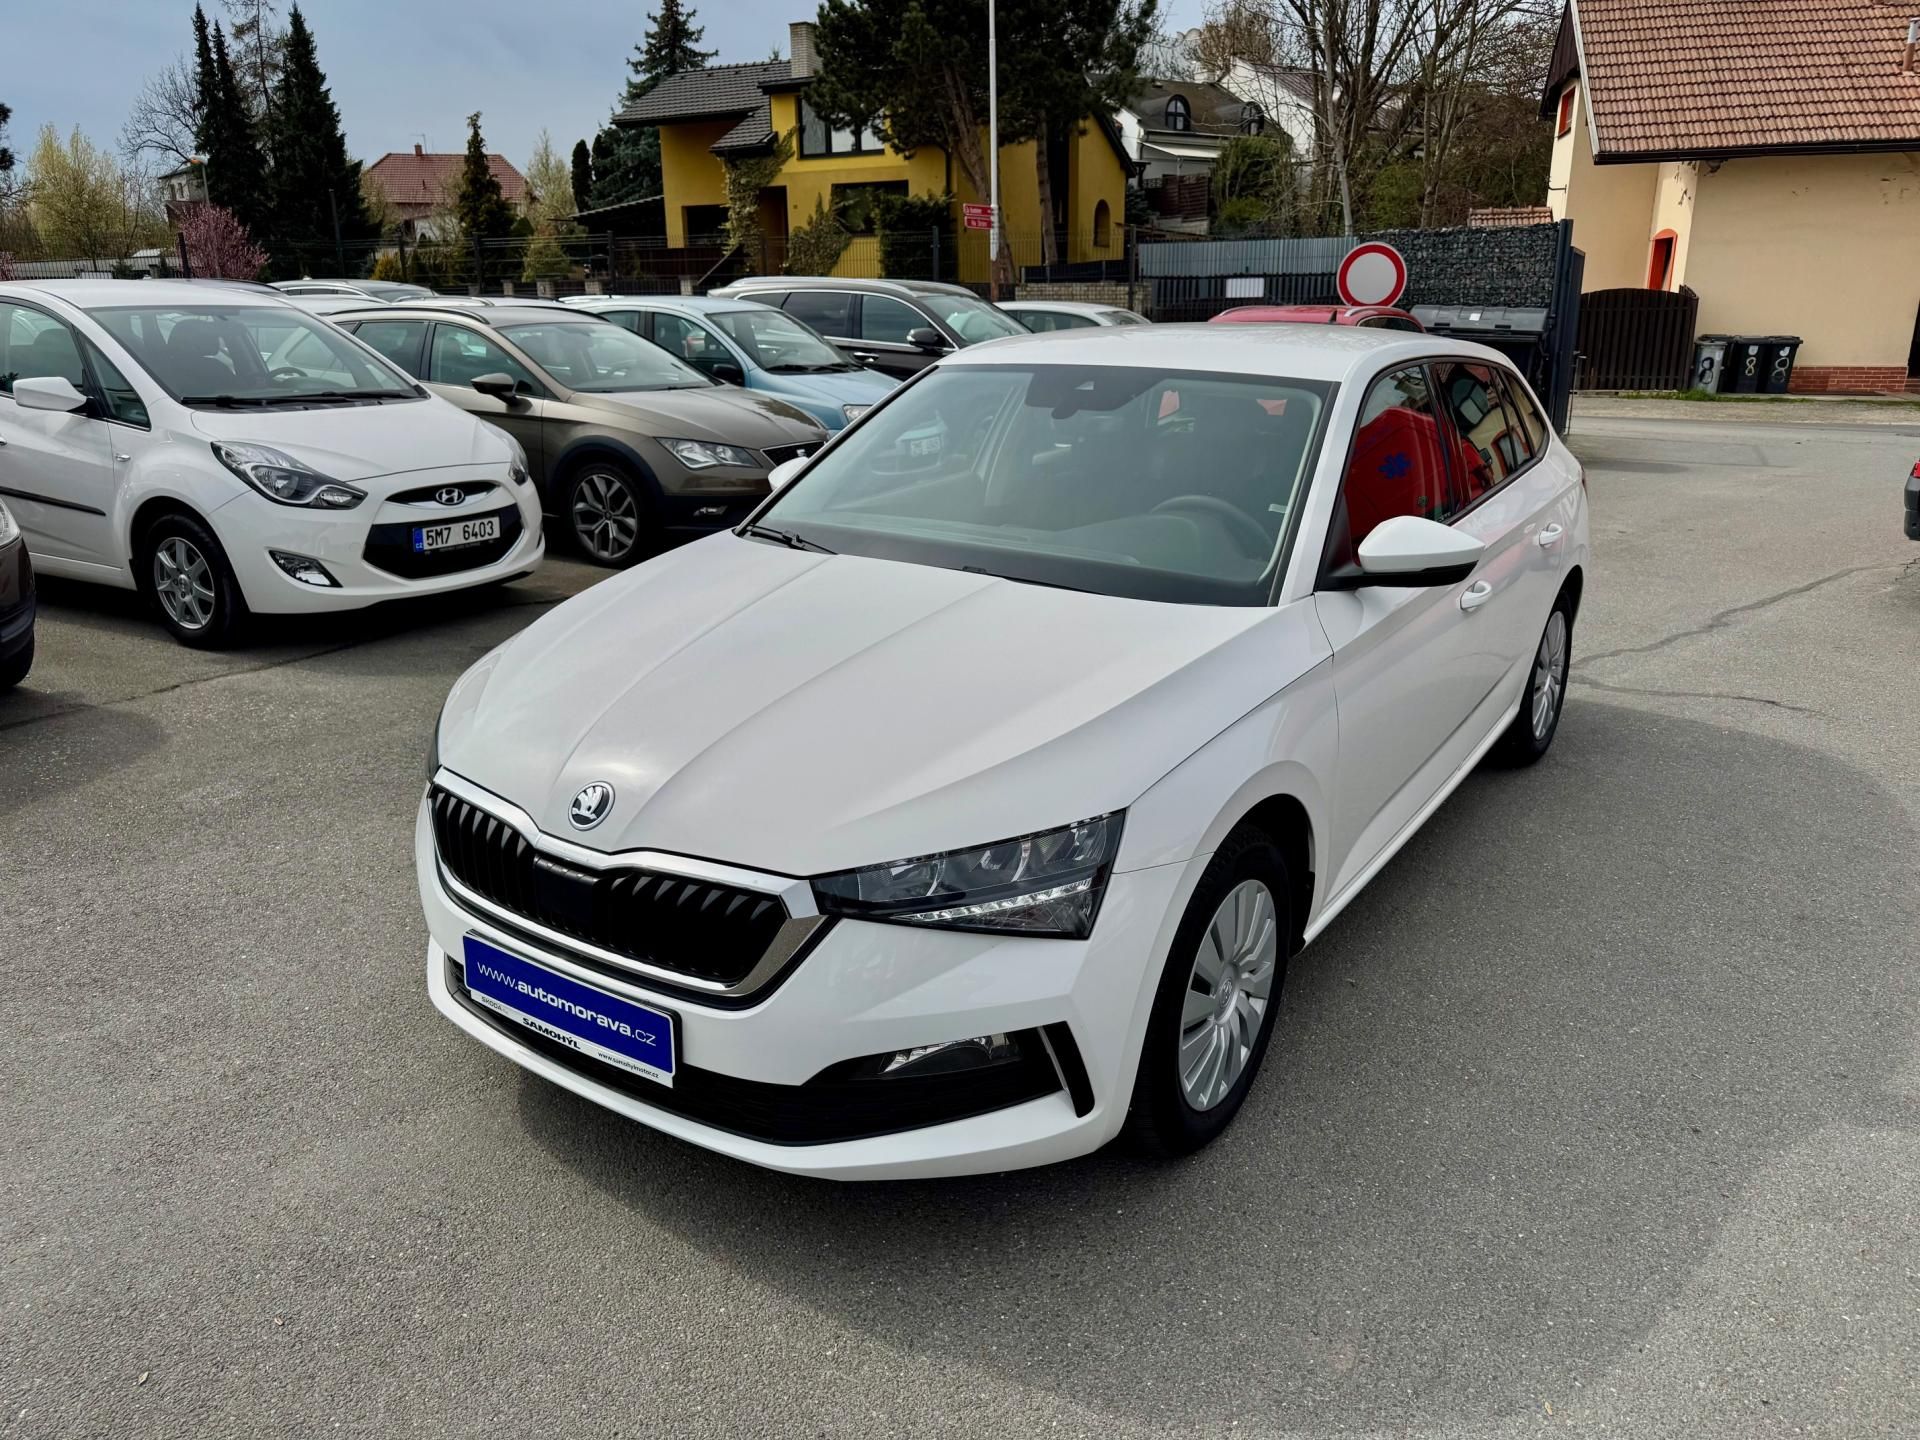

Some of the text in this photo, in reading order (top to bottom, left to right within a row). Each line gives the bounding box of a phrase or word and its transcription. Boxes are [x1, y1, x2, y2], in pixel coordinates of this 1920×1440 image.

[1745, 356, 1757, 376] 8
[426, 520, 494, 547] 5M7 6403
[477, 961, 657, 1046] www.automorava.cz
